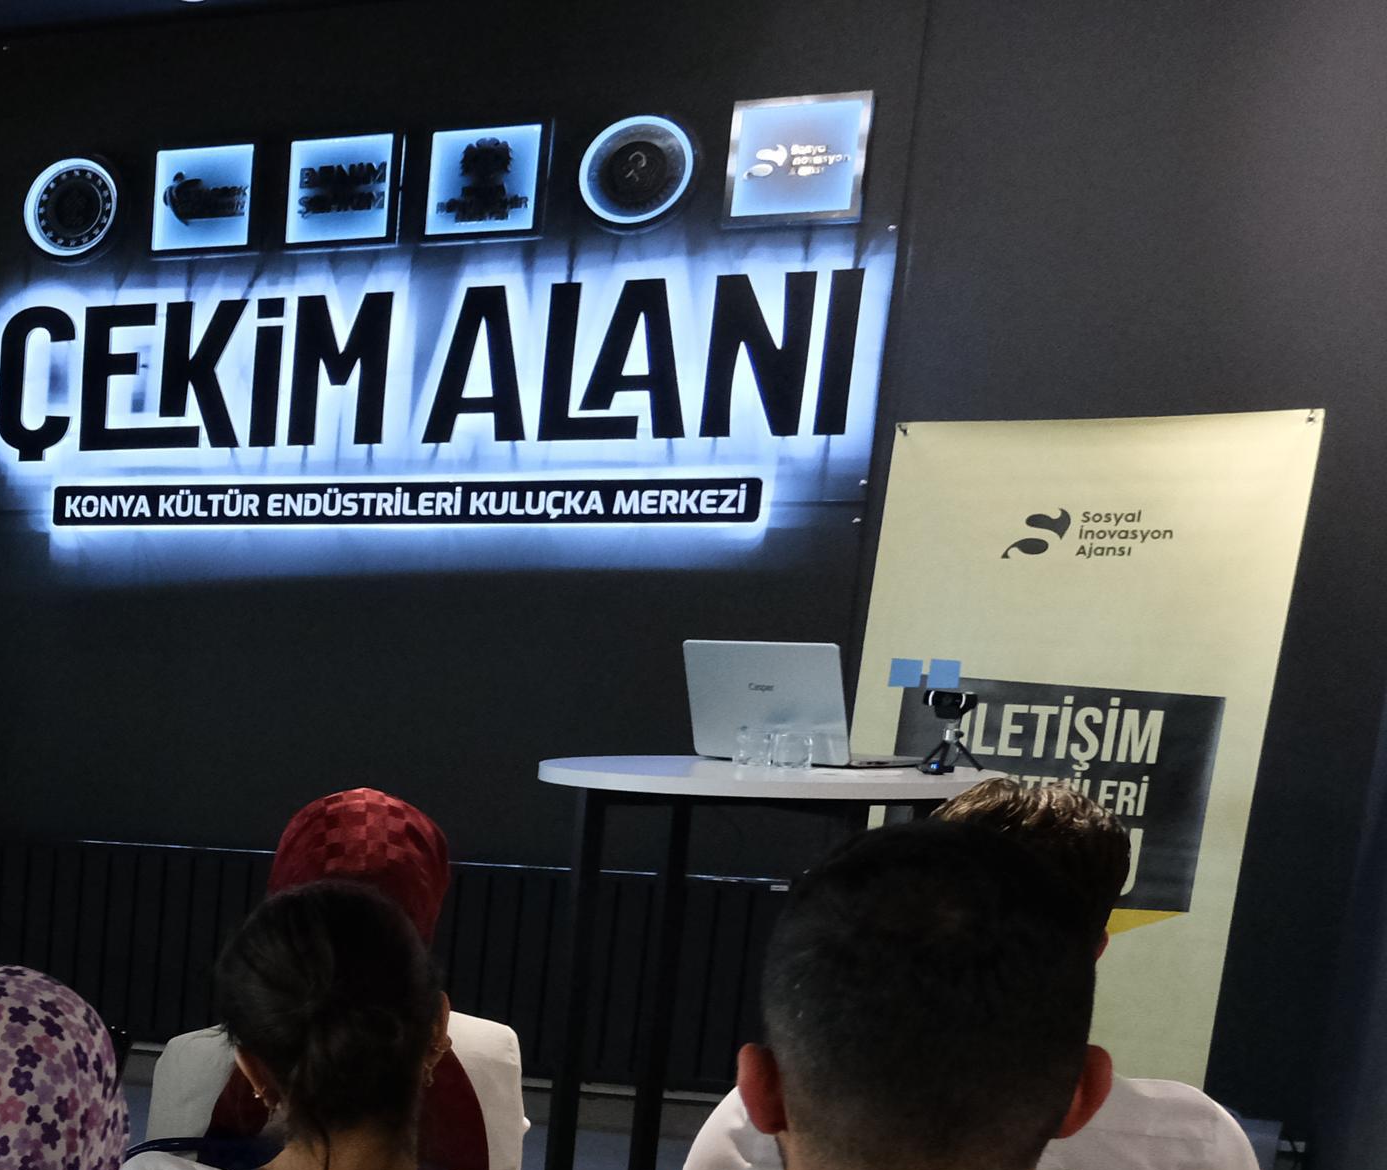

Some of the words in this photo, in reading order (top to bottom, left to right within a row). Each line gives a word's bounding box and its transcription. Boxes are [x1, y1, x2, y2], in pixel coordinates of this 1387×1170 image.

[421, 268, 865, 444] ALANI
[64, 494, 152, 518] KONYA
[157, 488, 260, 518] KÜLTÜR
[266, 486, 462, 517] ENDÜSTRİLERİ
[469, 490, 605, 519] KULUÇKA
[611, 483, 748, 515] MERKEZİ
[1081, 509, 1143, 526] Sosyal
[1075, 543, 1132, 559] Ajansı
